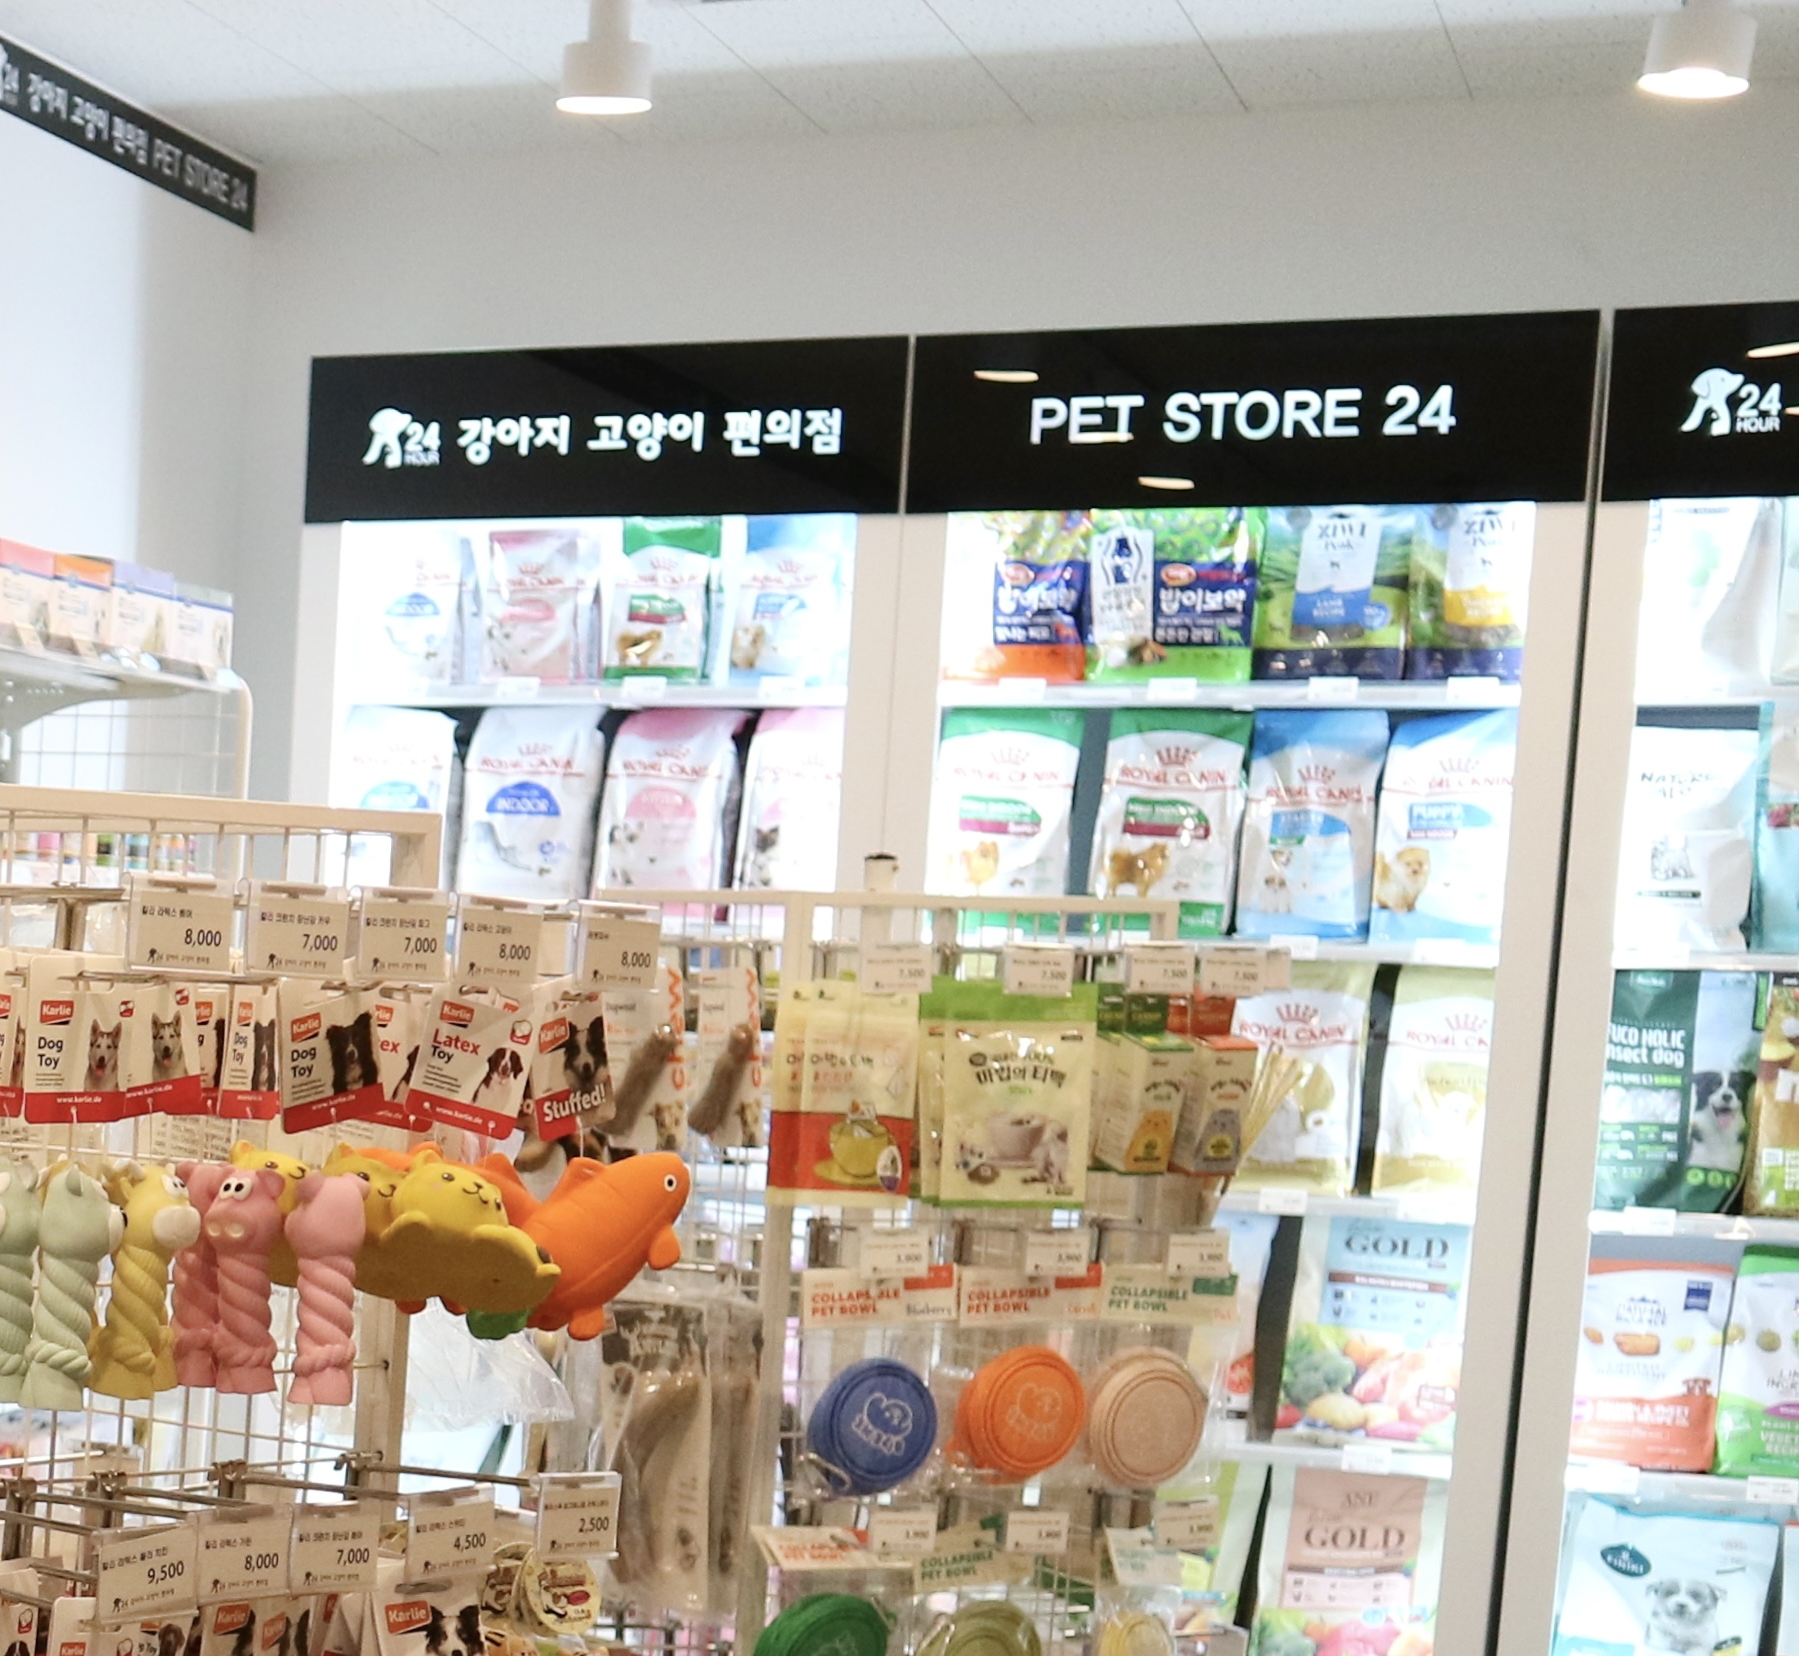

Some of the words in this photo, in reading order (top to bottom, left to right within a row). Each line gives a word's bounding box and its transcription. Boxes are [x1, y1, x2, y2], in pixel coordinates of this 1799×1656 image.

[153, 138, 180, 176] PET
[184, 152, 229, 204] STORE
[1735, 383, 1782, 415] 24
[1030, 396, 1144, 443] PET
[1162, 389, 1362, 442] STORE
[1382, 384, 1455, 436] 24
[1736, 416, 1781, 432] HOUR
[405, 421, 440, 451] 24
[457, 414, 571, 465] 강아지
[586, 411, 704, 460] 고양이
[723, 407, 843, 457] 편의점
[184, 928, 222, 948] 8,000
[302, 933, 338, 952] 7,000
[498, 943, 531, 961] 8,000
[40, 1002, 73, 1016] Karlie
[36, 1037, 64, 1055] Dog
[432, 1029, 481, 1057] Latex
[37, 1053, 64, 1073] Toy
[432, 1045, 455, 1063] Toy
[57, 1095, 103, 1106] www.karlie.de
[542, 1089, 606, 1121] Stuffed!
[1344, 1235, 1450, 1260] GOLD
[966, 1287, 1051, 1303] COLLAPSIBLE
[967, 1302, 987, 1314] PET
[989, 1300, 1030, 1313] BOWL
[578, 1516, 610, 1534] 2,500
[453, 1532, 487, 1552] 4,500
[1303, 1523, 1406, 1551] GOLD
[147, 1560, 185, 1583] 9,500
[244, 1552, 279, 1573] 8,000
[389, 1607, 428, 1628] Karlie
